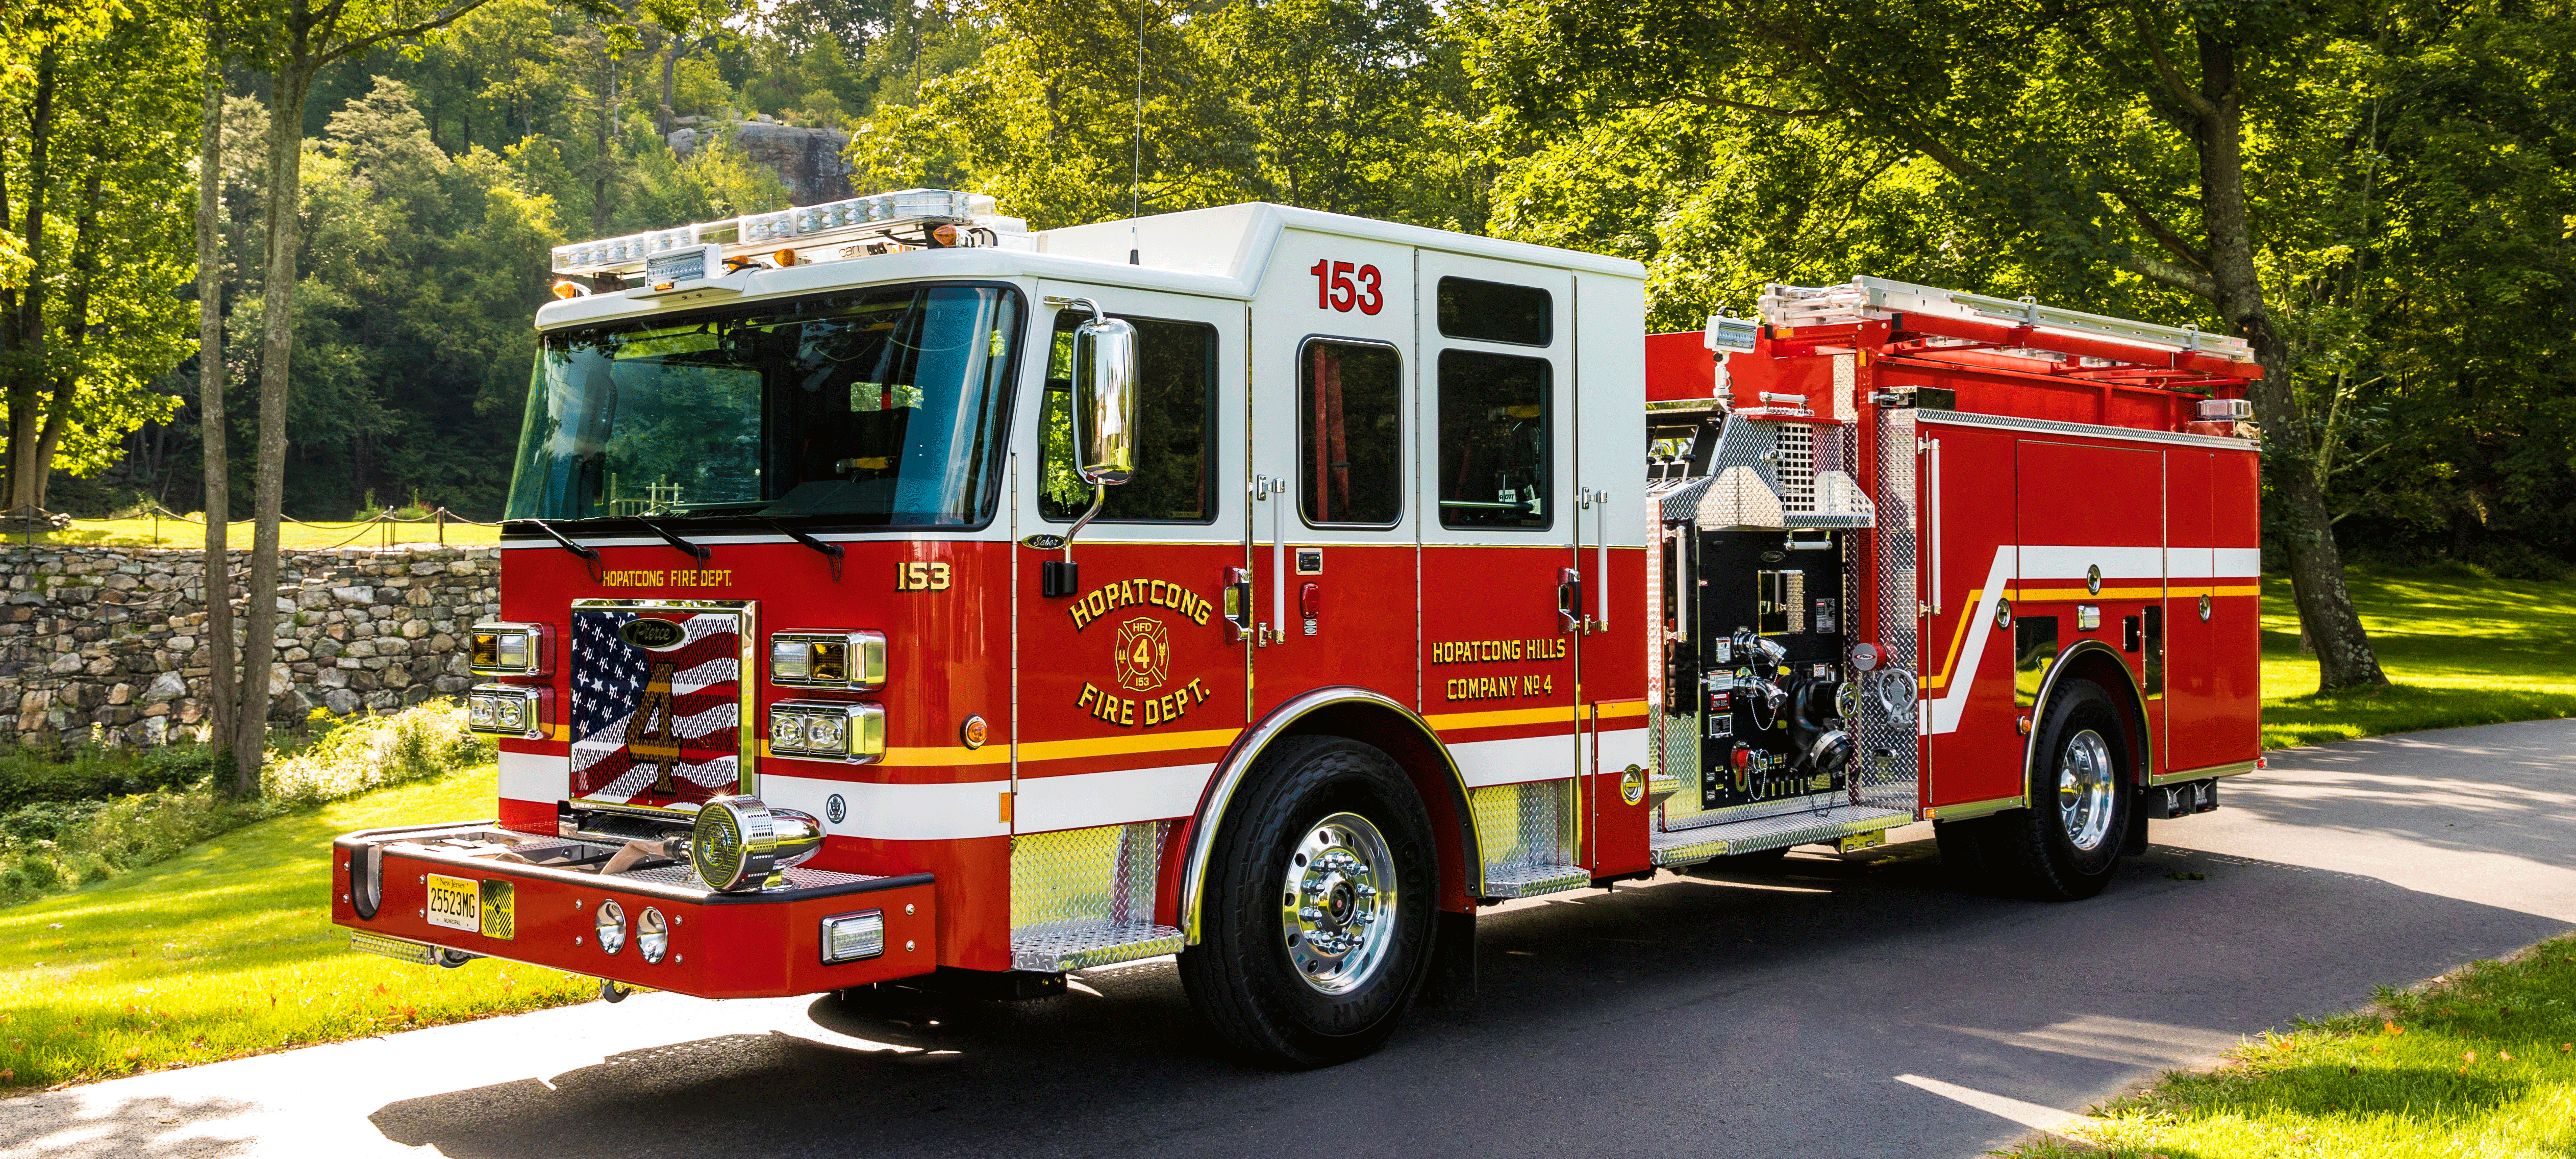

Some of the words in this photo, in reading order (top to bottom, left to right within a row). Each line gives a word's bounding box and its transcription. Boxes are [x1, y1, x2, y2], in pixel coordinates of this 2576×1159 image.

[1311, 259, 1383, 316] 153
[1034, 536, 1058, 546] Sabor
[603, 570, 664, 587] HOPATCONG
[670, 570, 697, 587] FIRE
[701, 570, 732, 587] DEPT.
[897, 562, 951, 590] 153
[1069, 578, 1213, 629] HOPATCONG
[633, 622, 670, 642] Pierce
[1133, 622, 1152, 632] HFD
[1133, 638, 1150, 669] 4
[1433, 640, 1521, 663] HOPATCONG
[1527, 639, 1566, 659] HILLS
[1135, 677, 1149, 686] 153
[1447, 676, 1518, 699] COMPANY
[1543, 674, 1552, 694] 4
[1078, 682, 1136, 725] FIRE
[1145, 677, 1210, 725] DEPT.
[627, 663, 681, 792] 4
[431, 887, 475, 918] 25523MG
